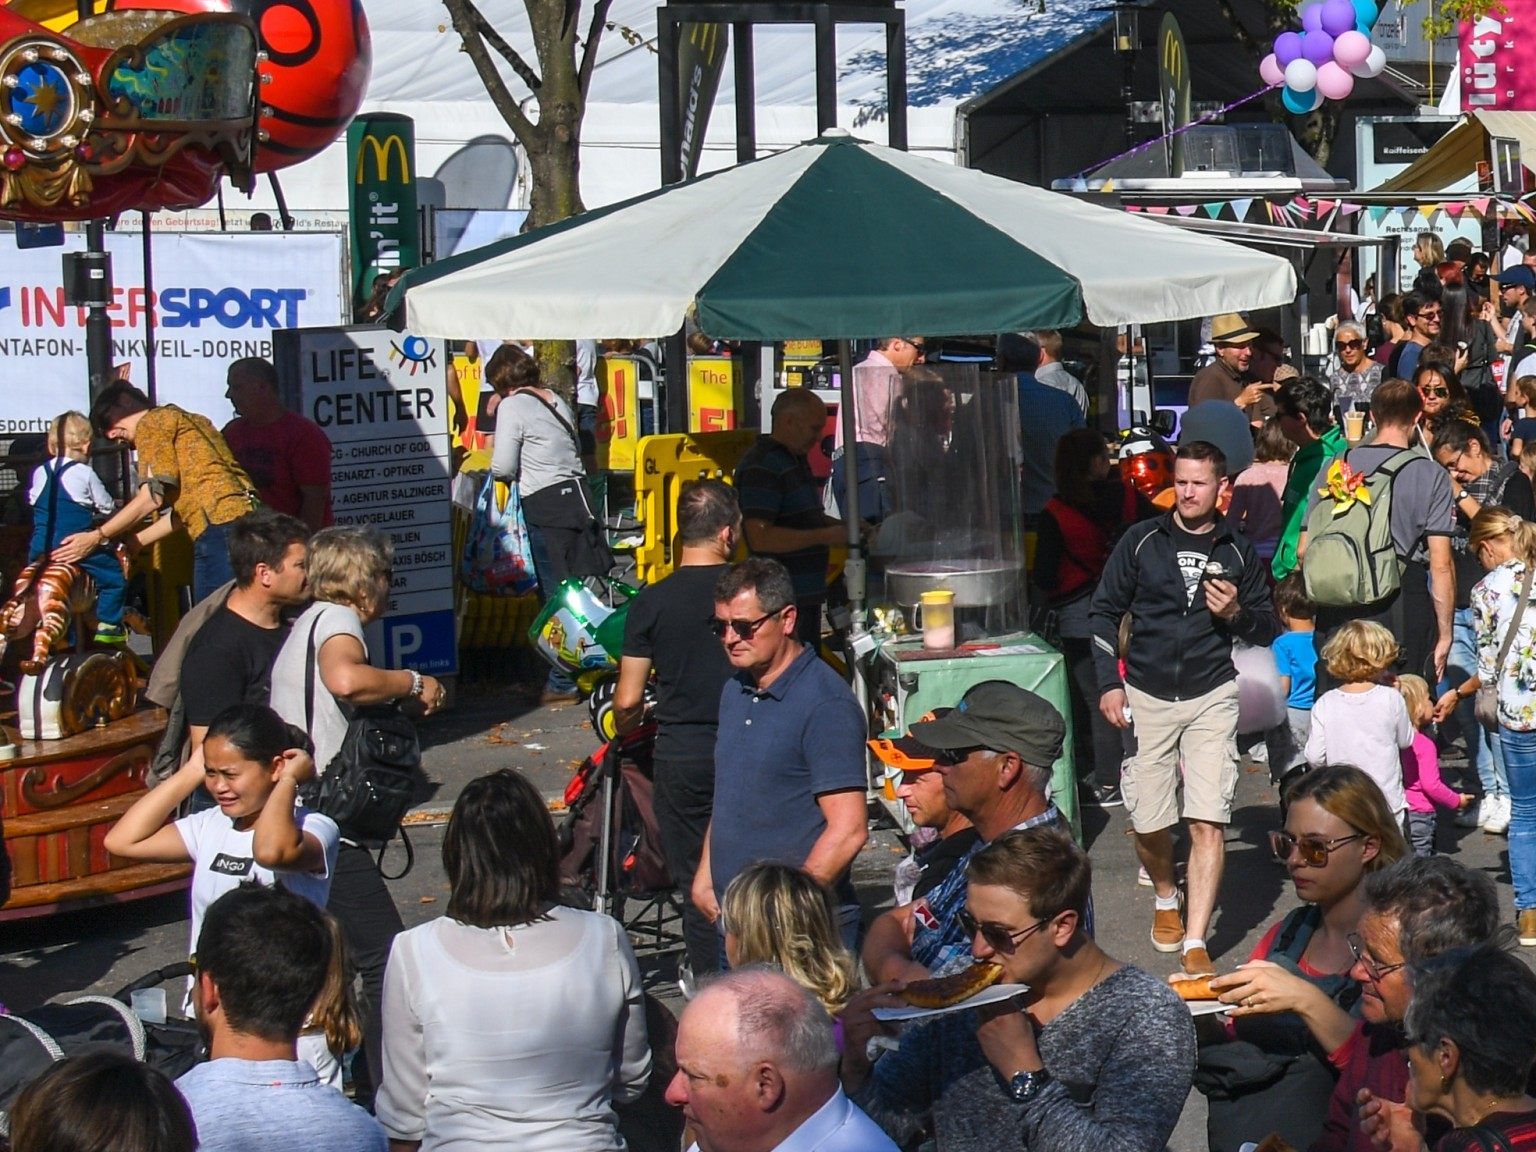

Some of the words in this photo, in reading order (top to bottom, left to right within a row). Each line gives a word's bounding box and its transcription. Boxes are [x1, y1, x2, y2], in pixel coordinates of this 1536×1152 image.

[312, 348, 376, 382] LIFE
[700, 370, 728, 384] The
[313, 388, 435, 427] CENTER
[352, 445, 391, 457] CHURCH
[394, 443, 407, 454] OF
[409, 441, 430, 453] GOD
[383, 464, 425, 477] OPTIKER
[343, 490, 389, 504] AGENTUR
[391, 484, 444, 499] SALZINGER
[355, 509, 415, 524] VOGELAUER
[415, 550, 445, 564] BÖSCH
[392, 624, 422, 670] P
